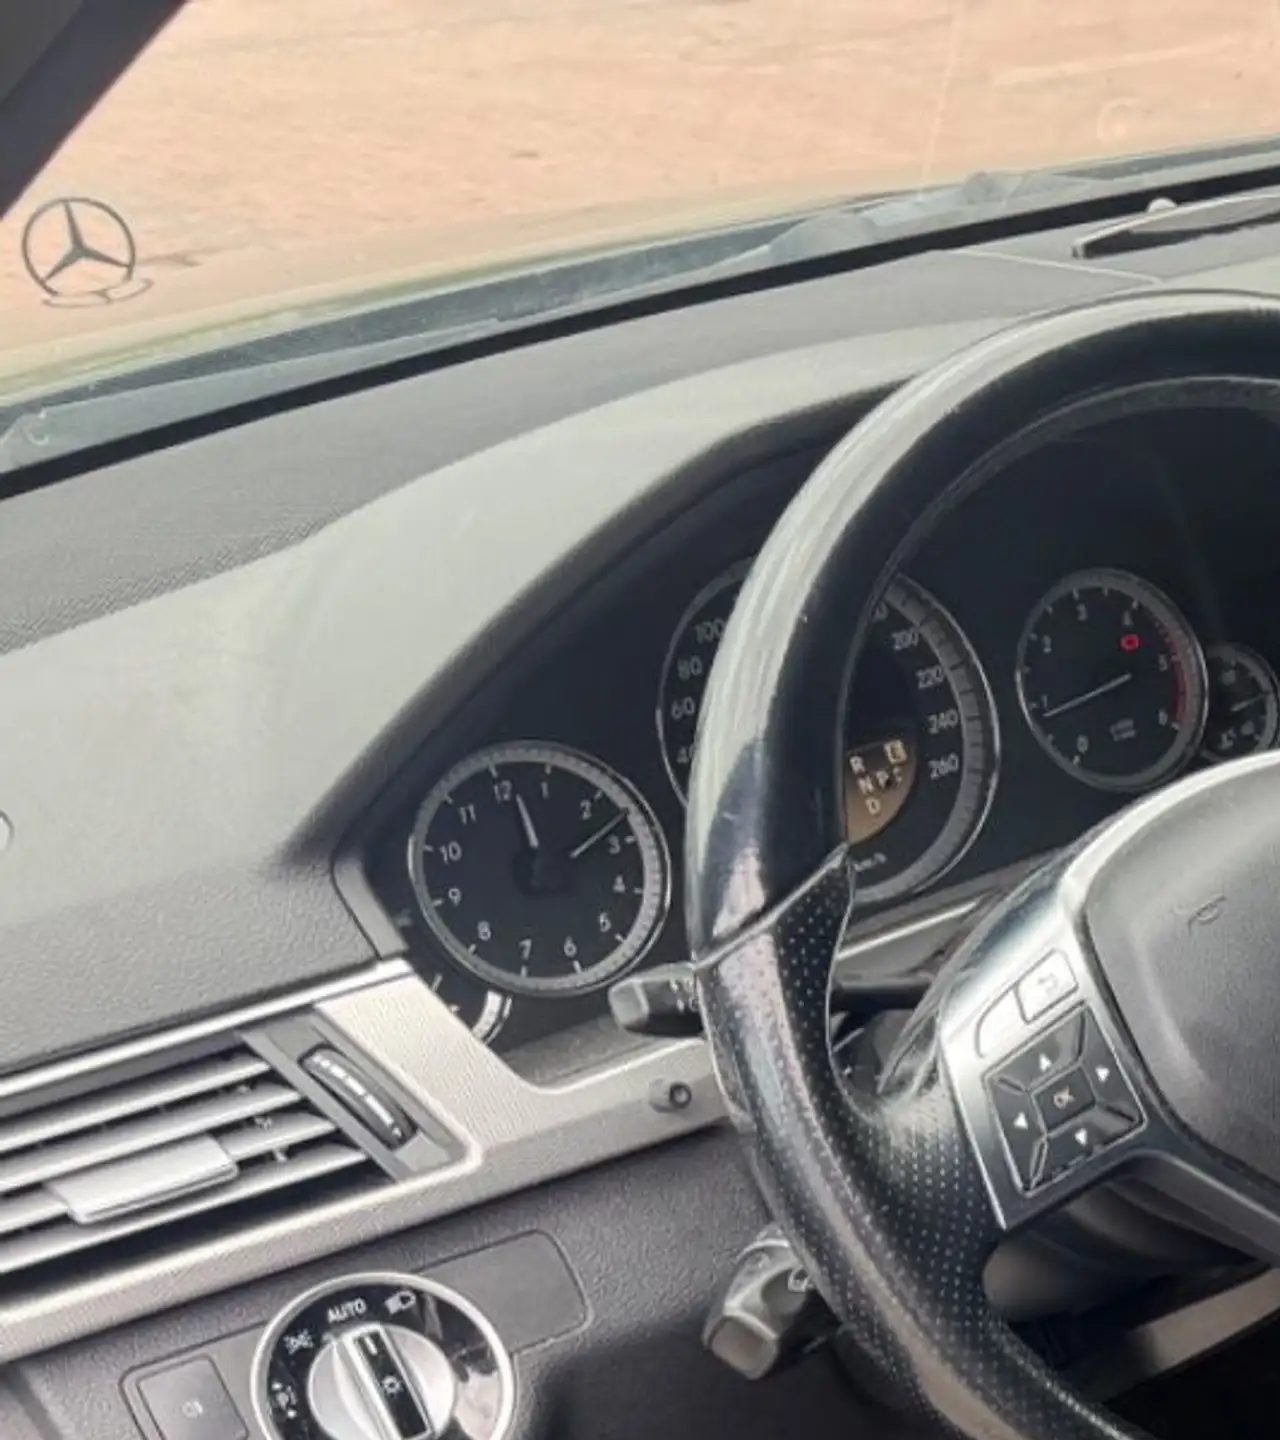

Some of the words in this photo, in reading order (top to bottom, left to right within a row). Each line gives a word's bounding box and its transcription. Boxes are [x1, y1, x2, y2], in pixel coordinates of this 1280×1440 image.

[694, 618, 726, 645] 100
[891, 629, 920, 651] 200
[916, 664, 945, 689] 220
[671, 696, 696, 721] 60
[928, 709, 959, 735] 240
[929, 753, 959, 780] 260
[494, 780, 512, 803] 12
[541, 782, 549, 798] 1
[458, 804, 477, 825] 11
[580, 800, 592, 820] 2
[439, 841, 462, 864] 10
[609, 835, 621, 854] 3
[613, 875, 625, 893] 4
[449, 887, 461, 906] 9
[477, 920, 491, 941] 8
[598, 912, 612, 932] 5
[519, 938, 532, 959] 7
[563, 936, 577, 957] 6
[328, 1299, 366, 1322] AUTO
